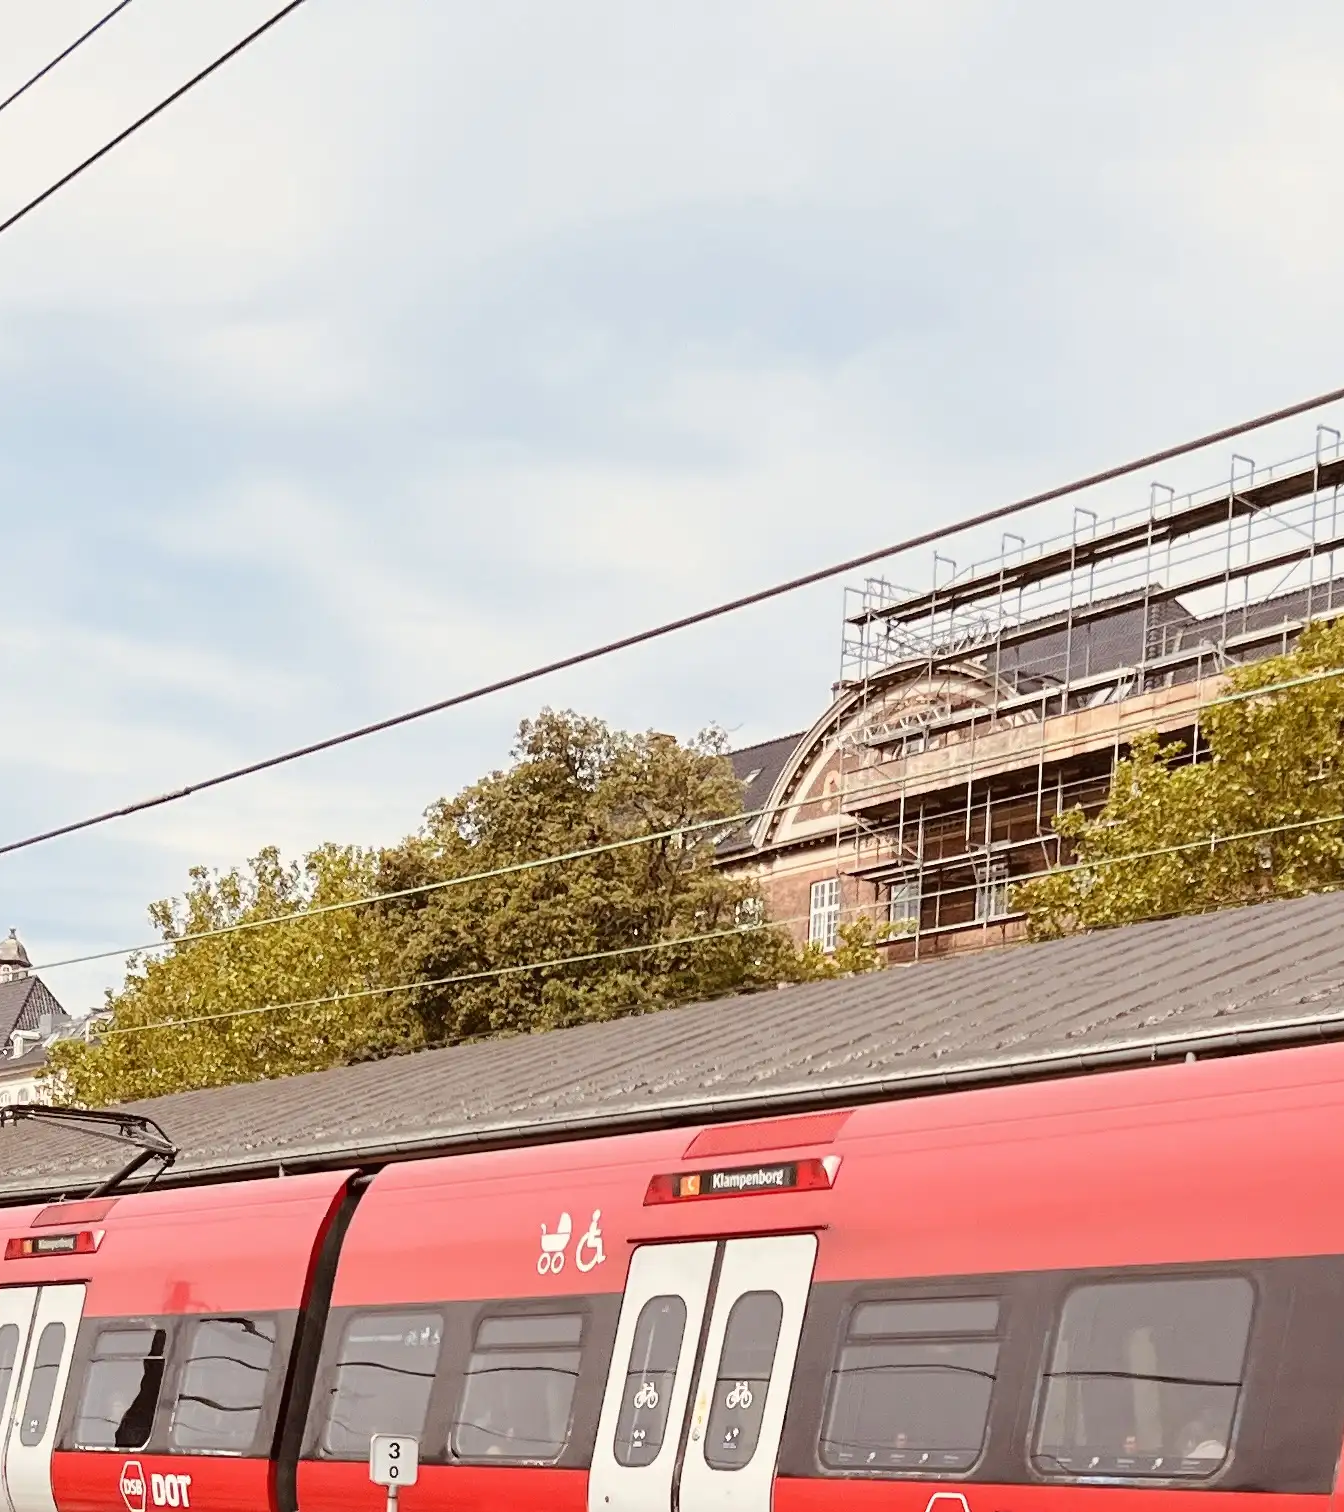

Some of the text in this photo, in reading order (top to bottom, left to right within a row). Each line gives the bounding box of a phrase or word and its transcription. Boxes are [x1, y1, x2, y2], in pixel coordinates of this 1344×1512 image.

[712, 1168, 785, 1191] Klampenborg
[388, 1442, 401, 1460] 3
[389, 1466, 399, 1479] 0
[151, 1473, 191, 1508] DOT
